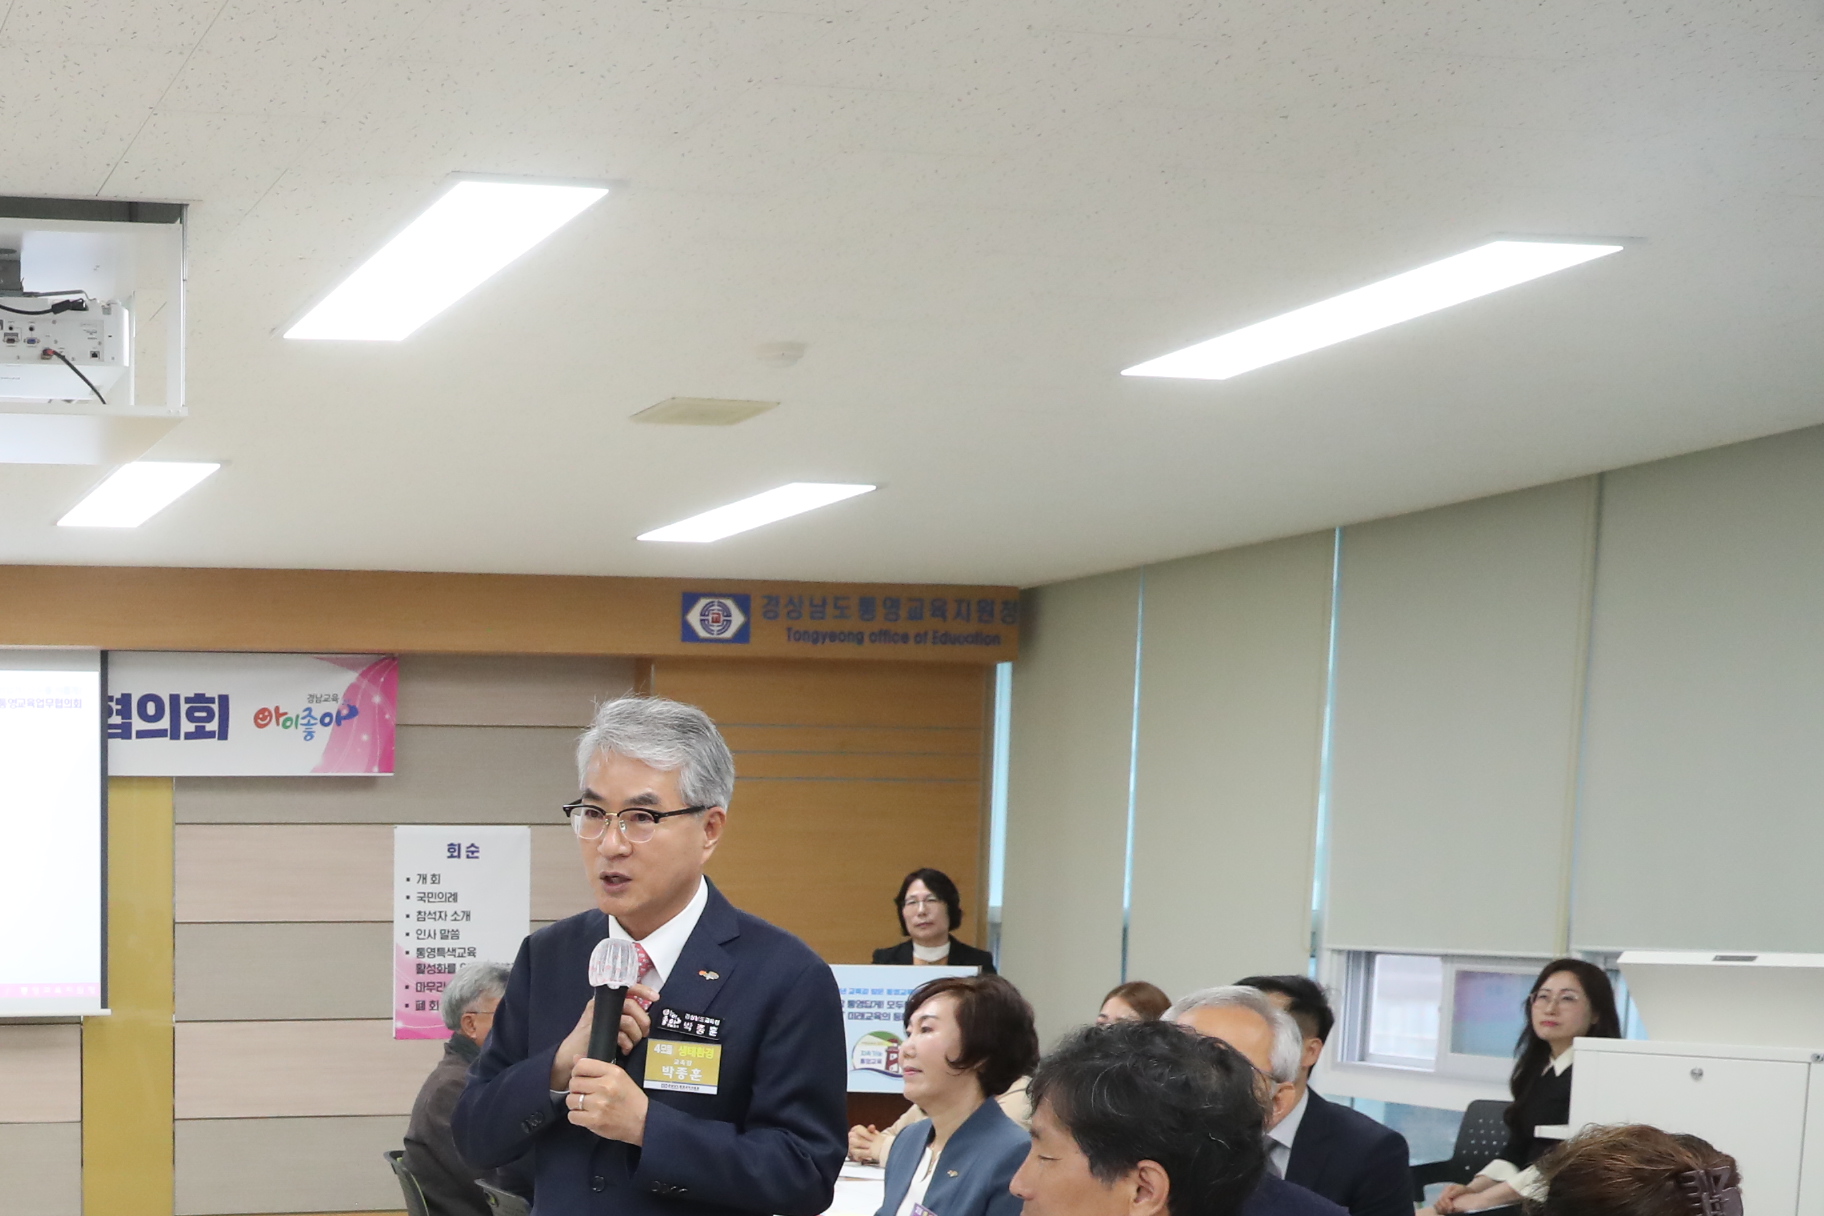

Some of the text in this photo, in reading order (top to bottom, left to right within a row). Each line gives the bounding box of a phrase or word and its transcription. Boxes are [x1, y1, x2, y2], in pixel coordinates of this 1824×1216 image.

[787, 626, 865, 645] Tongyeong
[914, 629, 929, 645] of
[932, 629, 1002, 646] Education
[306, 693, 340, 704] 경남교육
[416, 891, 458, 904] 국민의례
[416, 910, 471, 922] 참석자 소개
[415, 928, 461, 941] 인사 말씀
[416, 946, 477, 959] 통영특색교육
[416, 963, 456, 975] 활성화를
